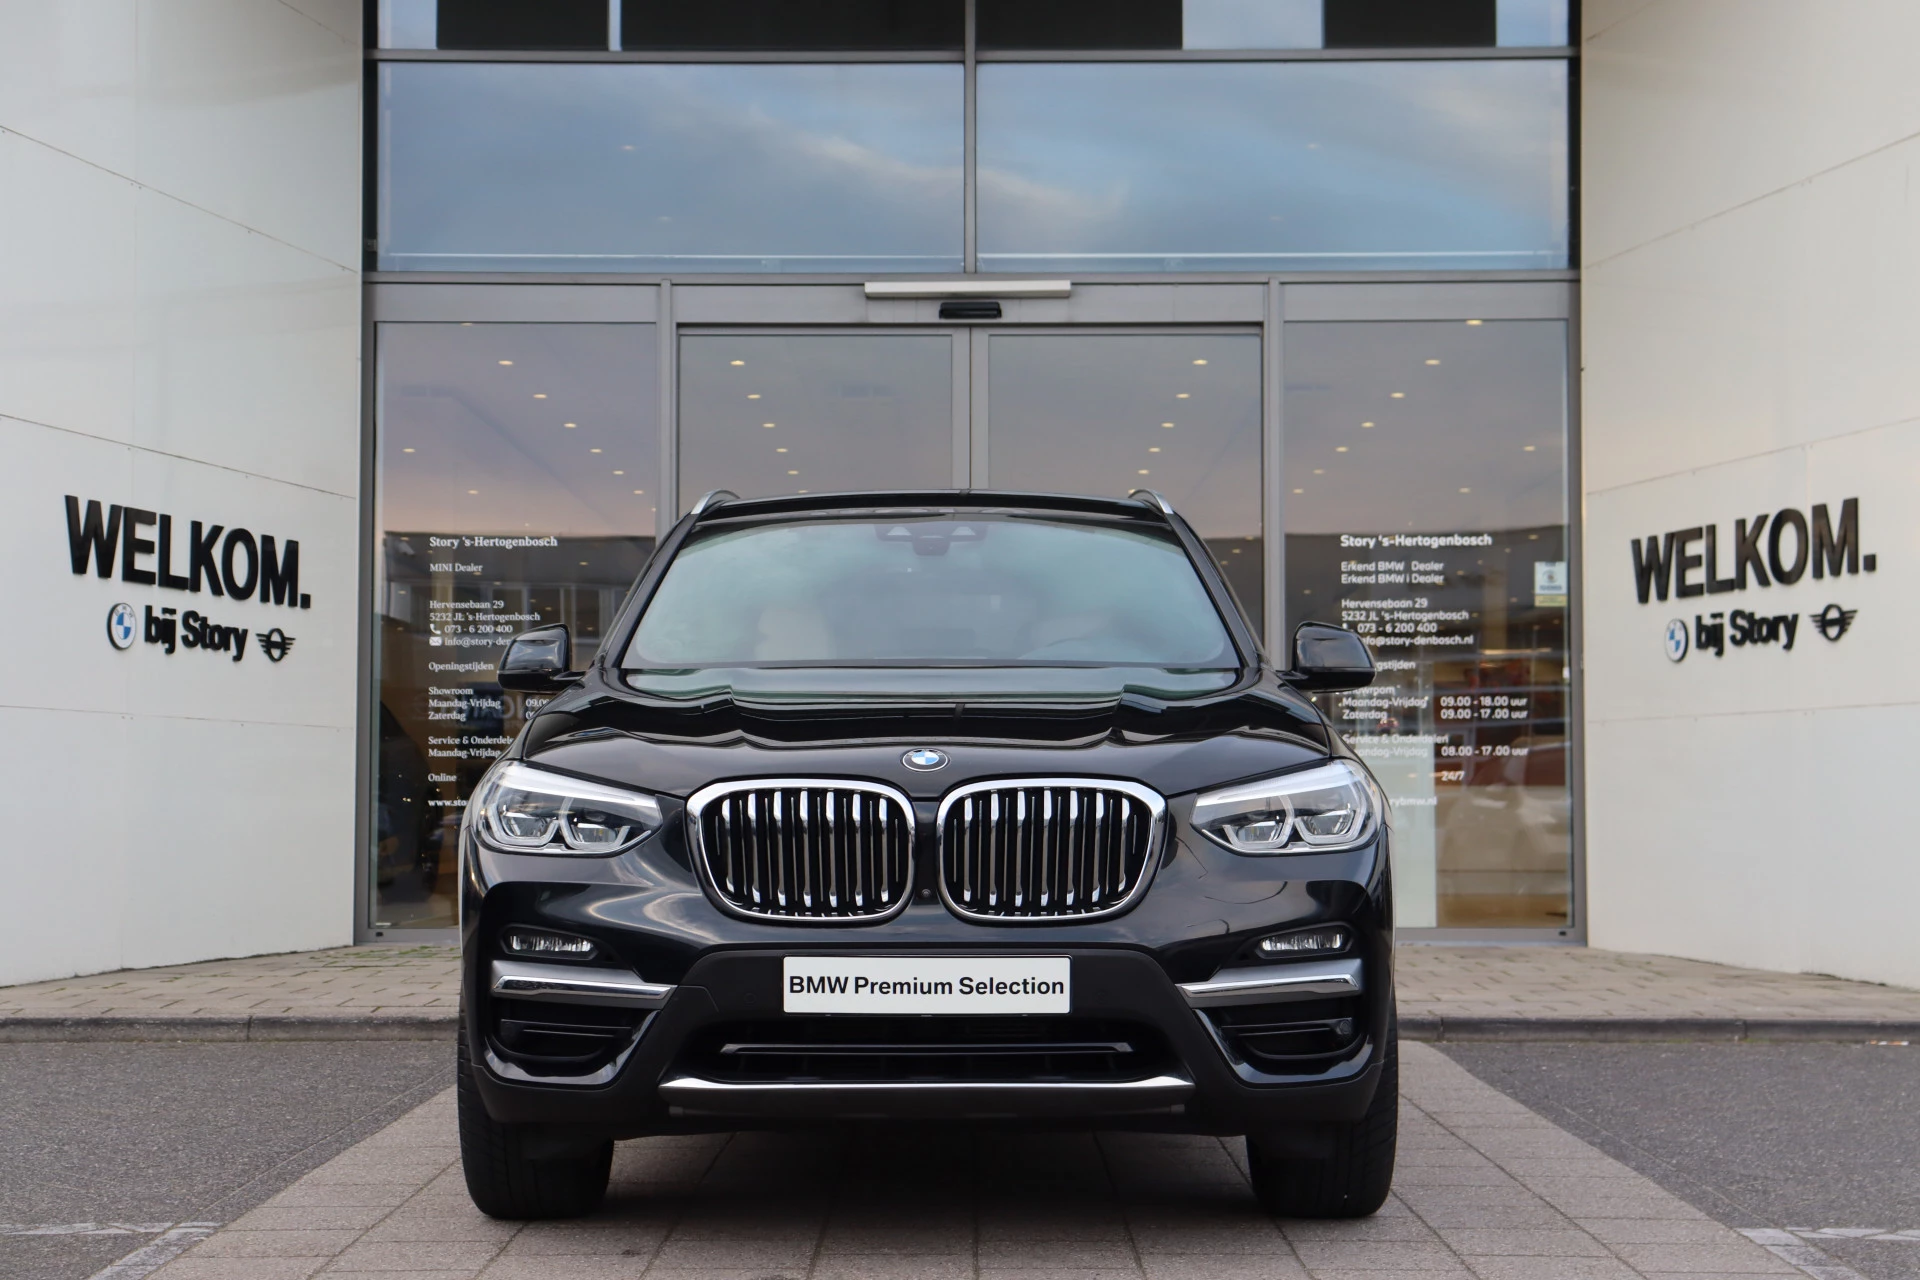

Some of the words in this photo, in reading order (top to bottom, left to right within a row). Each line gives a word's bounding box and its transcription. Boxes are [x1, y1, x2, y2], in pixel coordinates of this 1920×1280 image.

[429, 537, 460, 549] Story
[1340, 535, 1376, 549] Story
[64, 495, 311, 609] WELKOM.
[1631, 497, 1877, 604] WELKOM.
[429, 563, 452, 572] MINI
[455, 563, 483, 572] Dealer
[1341, 562, 1375, 572] Erkend
[1378, 562, 1404, 571] BMW
[1411, 561, 1444, 571] Dealer
[1341, 575, 1375, 584] Erkend
[1378, 574, 1404, 584] BMW
[1411, 574, 1444, 584] Dealer
[429, 600, 490, 609] Hervensebaan
[493, 600, 504, 609] 29
[1341, 599, 1412, 609] Hervensebaan
[1414, 598, 1428, 608] 29
[429, 612, 451, 621] 5232
[1341, 611, 1366, 621] 5232
[1368, 611, 1379, 622] JL
[144, 605, 176, 655] bij
[181, 610, 249, 662] Story
[444, 624, 461, 633] 073
[468, 624, 475, 633] 6
[477, 624, 495, 633] 200
[496, 624, 513, 633] 400
[1357, 623, 1375, 633] 073
[1385, 623, 1392, 633] 6
[1394, 623, 1415, 633] 200
[1417, 623, 1438, 633] 400
[1695, 611, 1724, 657] bij
[1729, 608, 1799, 652] Story
[1362, 635, 1474, 647] nfo@story-denbosch.nl
[428, 661, 494, 673] Openingstijden
[428, 687, 474, 695] Showroom
[428, 699, 501, 709] Maandag-Vrijdag
[1342, 697, 1428, 709] Maandag-Vrijdag
[1440, 696, 1472, 707] 09.00
[1480, 696, 1509, 707] 18.00
[1512, 698, 1528, 707] uur
[428, 711, 467, 721] Zaterdag
[1342, 710, 1388, 721] Zaterdag
[1440, 709, 1472, 719] 09.00
[1512, 711, 1528, 719] uur
[428, 736, 460, 745] Service
[462, 736, 469, 745] &
[1441, 746, 1473, 756] 08.00
[1512, 748, 1528, 756] uur
[427, 773, 457, 782] Online
[1441, 771, 1465, 781] 24/7
[789, 976, 849, 994] BMW
[854, 976, 953, 995] Premium
[958, 976, 1065, 995] Selection
